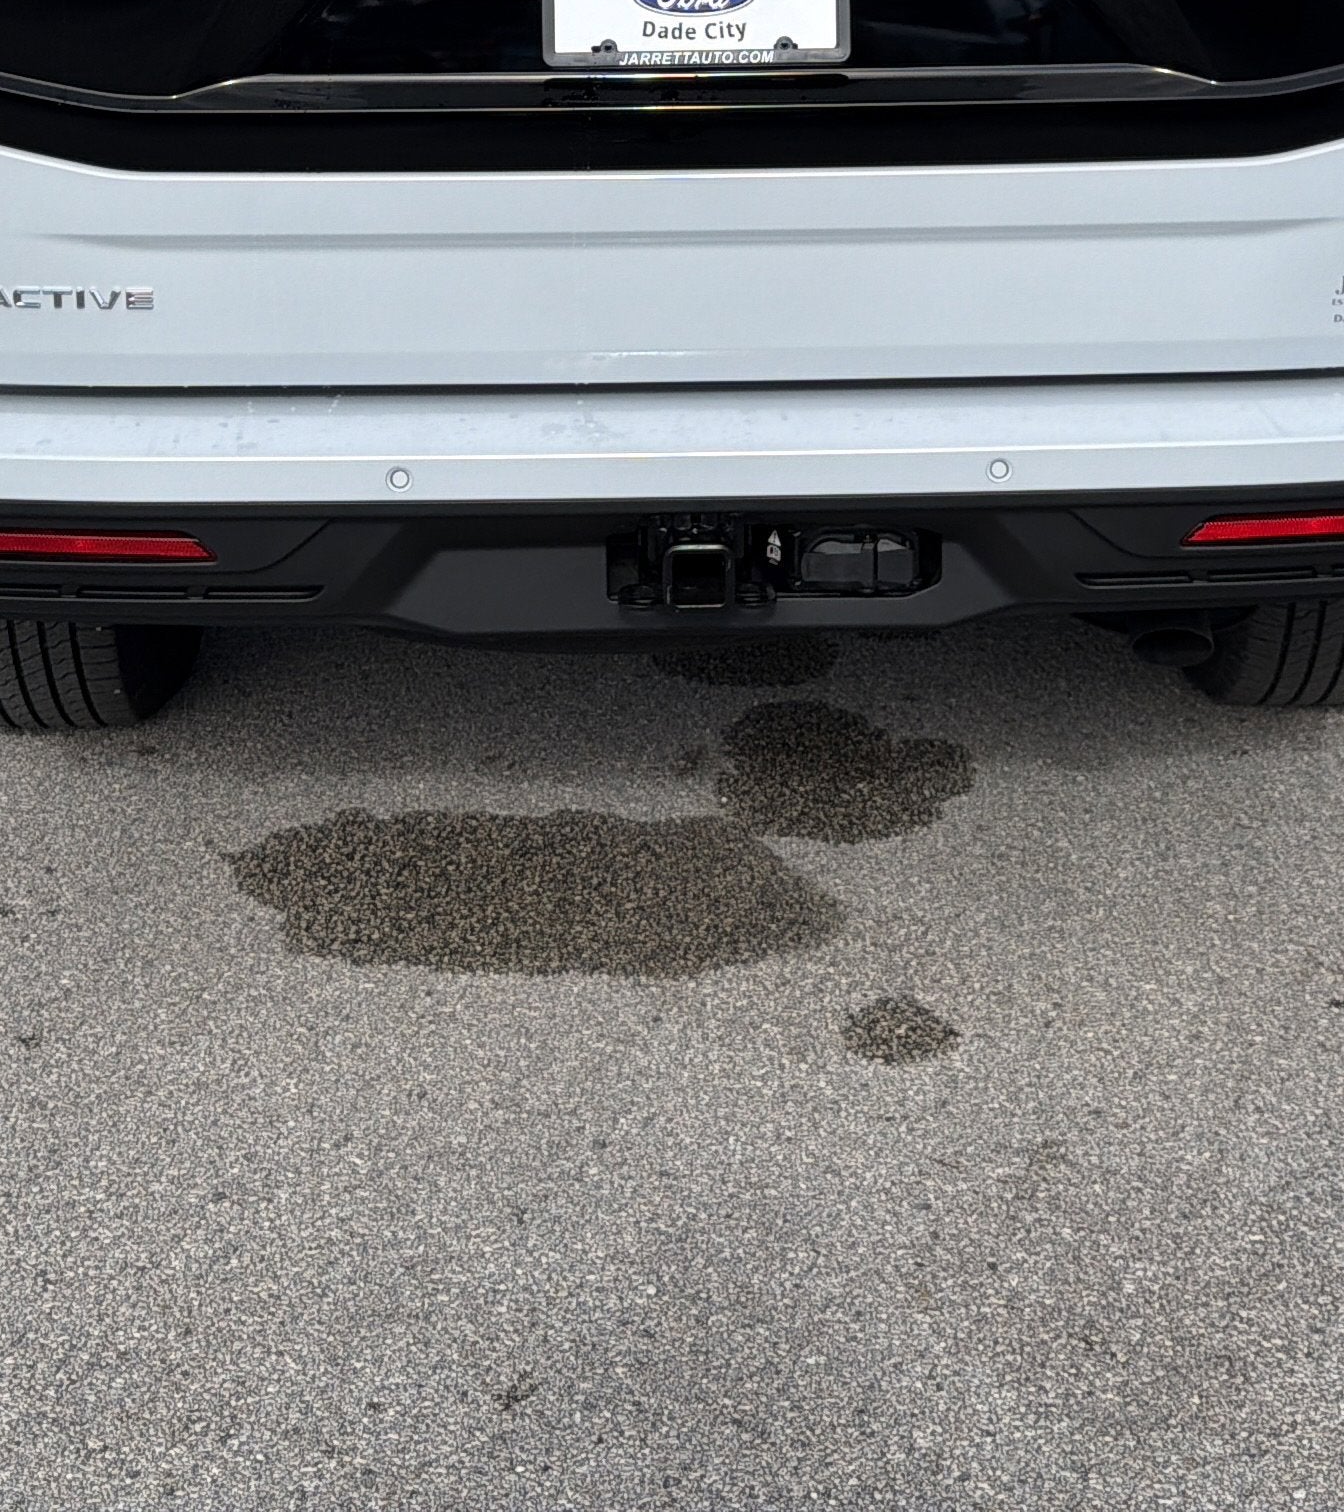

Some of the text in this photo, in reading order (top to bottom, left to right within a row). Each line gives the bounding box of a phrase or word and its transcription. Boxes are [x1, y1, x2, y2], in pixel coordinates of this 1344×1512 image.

[642, 20, 748, 42] Dade City
[619, 50, 774, 66] JARRETTAUTO.COM
